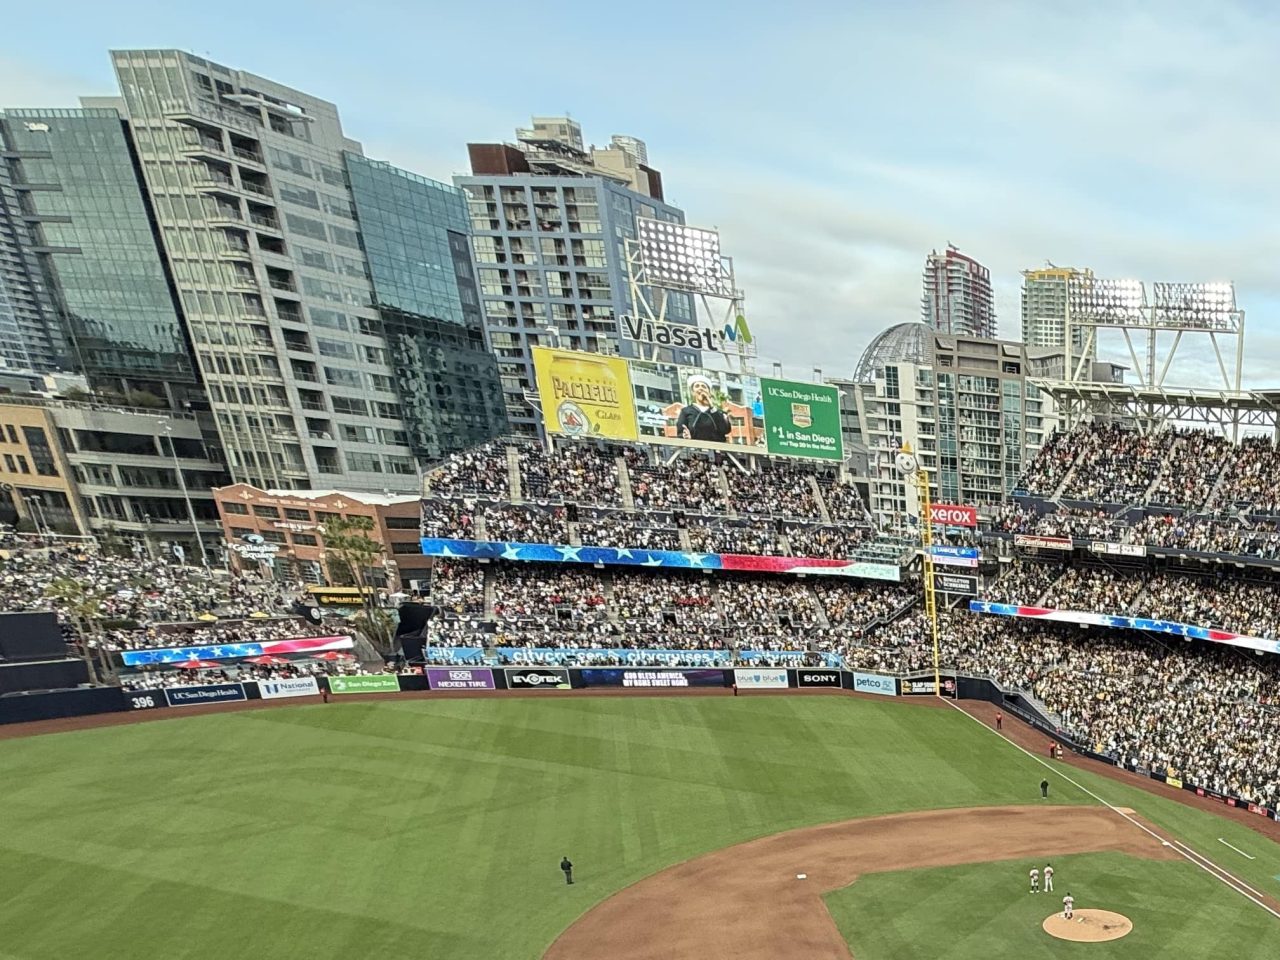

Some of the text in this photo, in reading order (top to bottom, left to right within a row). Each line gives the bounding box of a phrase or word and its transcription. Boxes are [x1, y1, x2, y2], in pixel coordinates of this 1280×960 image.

[624, 315, 718, 351] Viasat
[780, 388, 792, 398] San
[793, 390, 811, 401] Diego
[812, 393, 832, 403] Health
[786, 431, 794, 439] in
[796, 432, 811, 441] San
[812, 434, 835, 445] Diego
[930, 508, 970, 522] xerox
[232, 544, 280, 556] Gallagher
[241, 551, 275, 560] Square
[431, 649, 455, 660] city
[627, 652, 709, 662] citycruises
[512, 675, 562, 684] EVOTEK
[803, 674, 836, 682] SONY
[280, 681, 314, 690] National
[856, 678, 881, 690] petco
[185, 691, 198, 699] San
[198, 690, 217, 699] Diego
[217, 688, 238, 697] Health
[132, 696, 154, 708] 396
